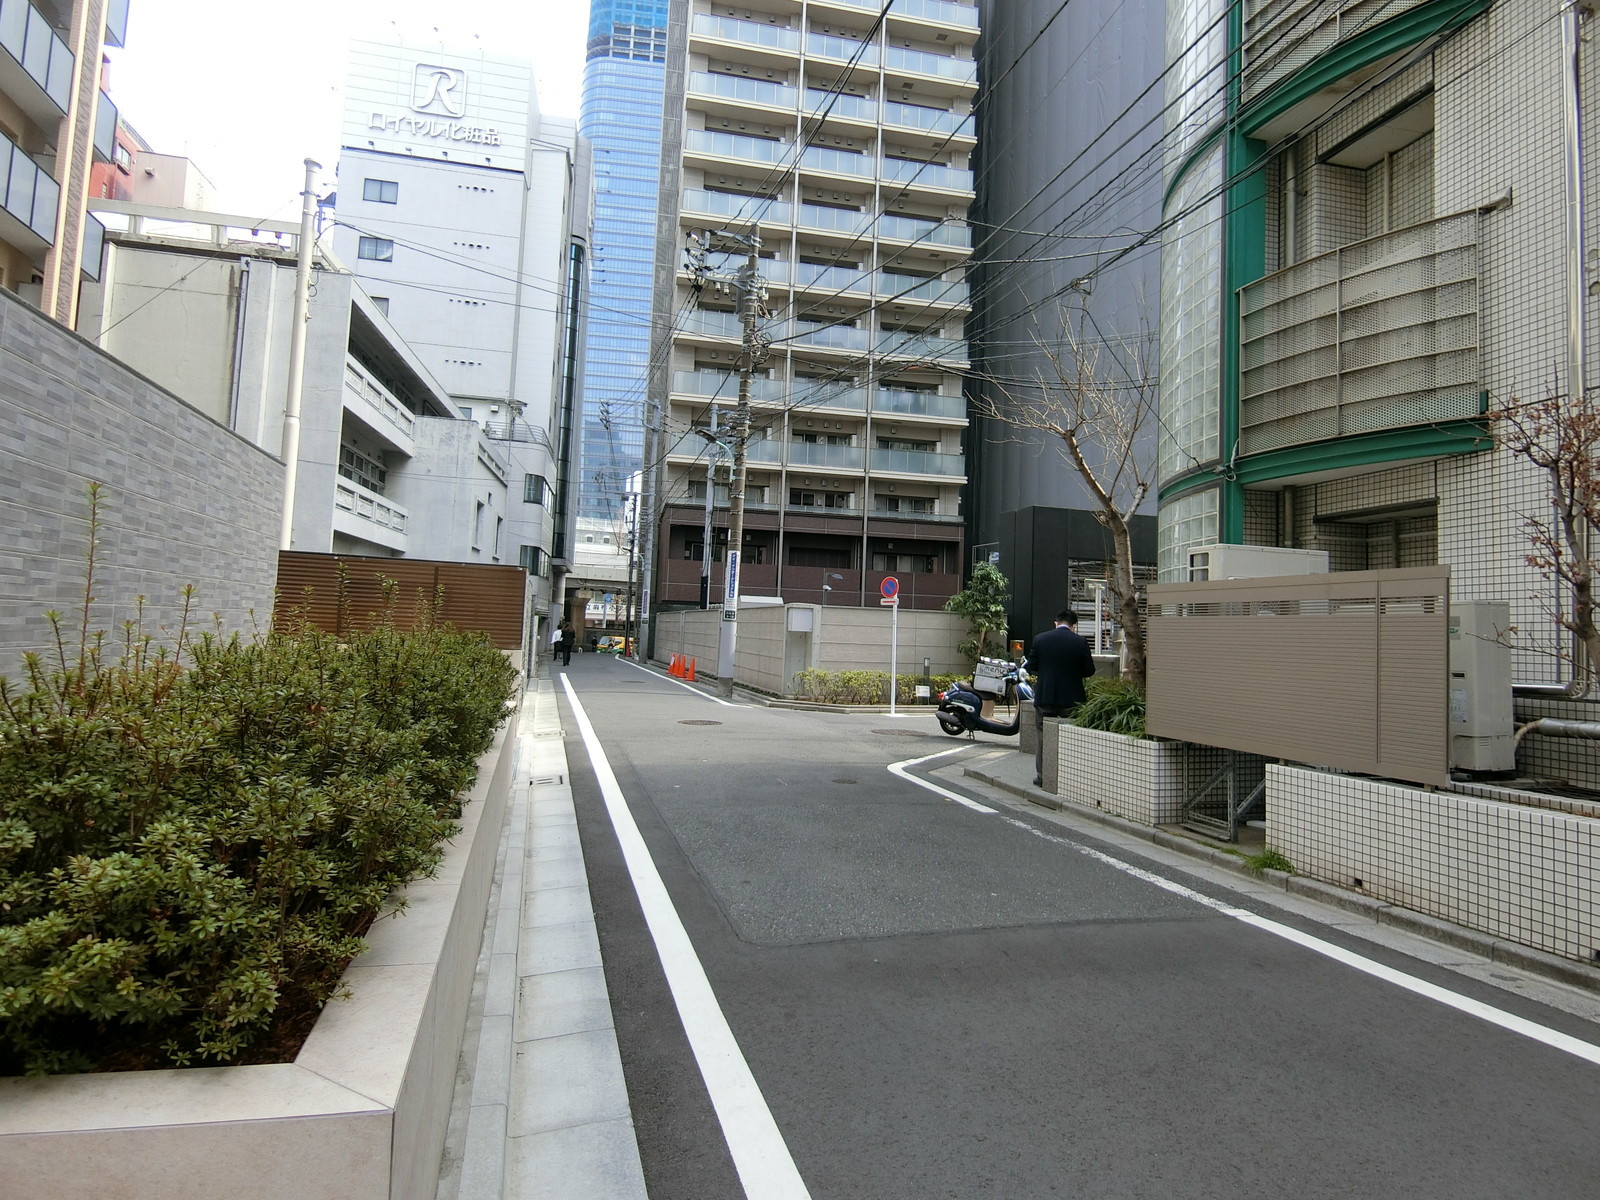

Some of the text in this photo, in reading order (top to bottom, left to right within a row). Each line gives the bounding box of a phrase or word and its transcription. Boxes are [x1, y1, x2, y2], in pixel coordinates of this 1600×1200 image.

[416, 68, 459, 115] R
[367, 112, 502, 147] ロイヤル化粧品
